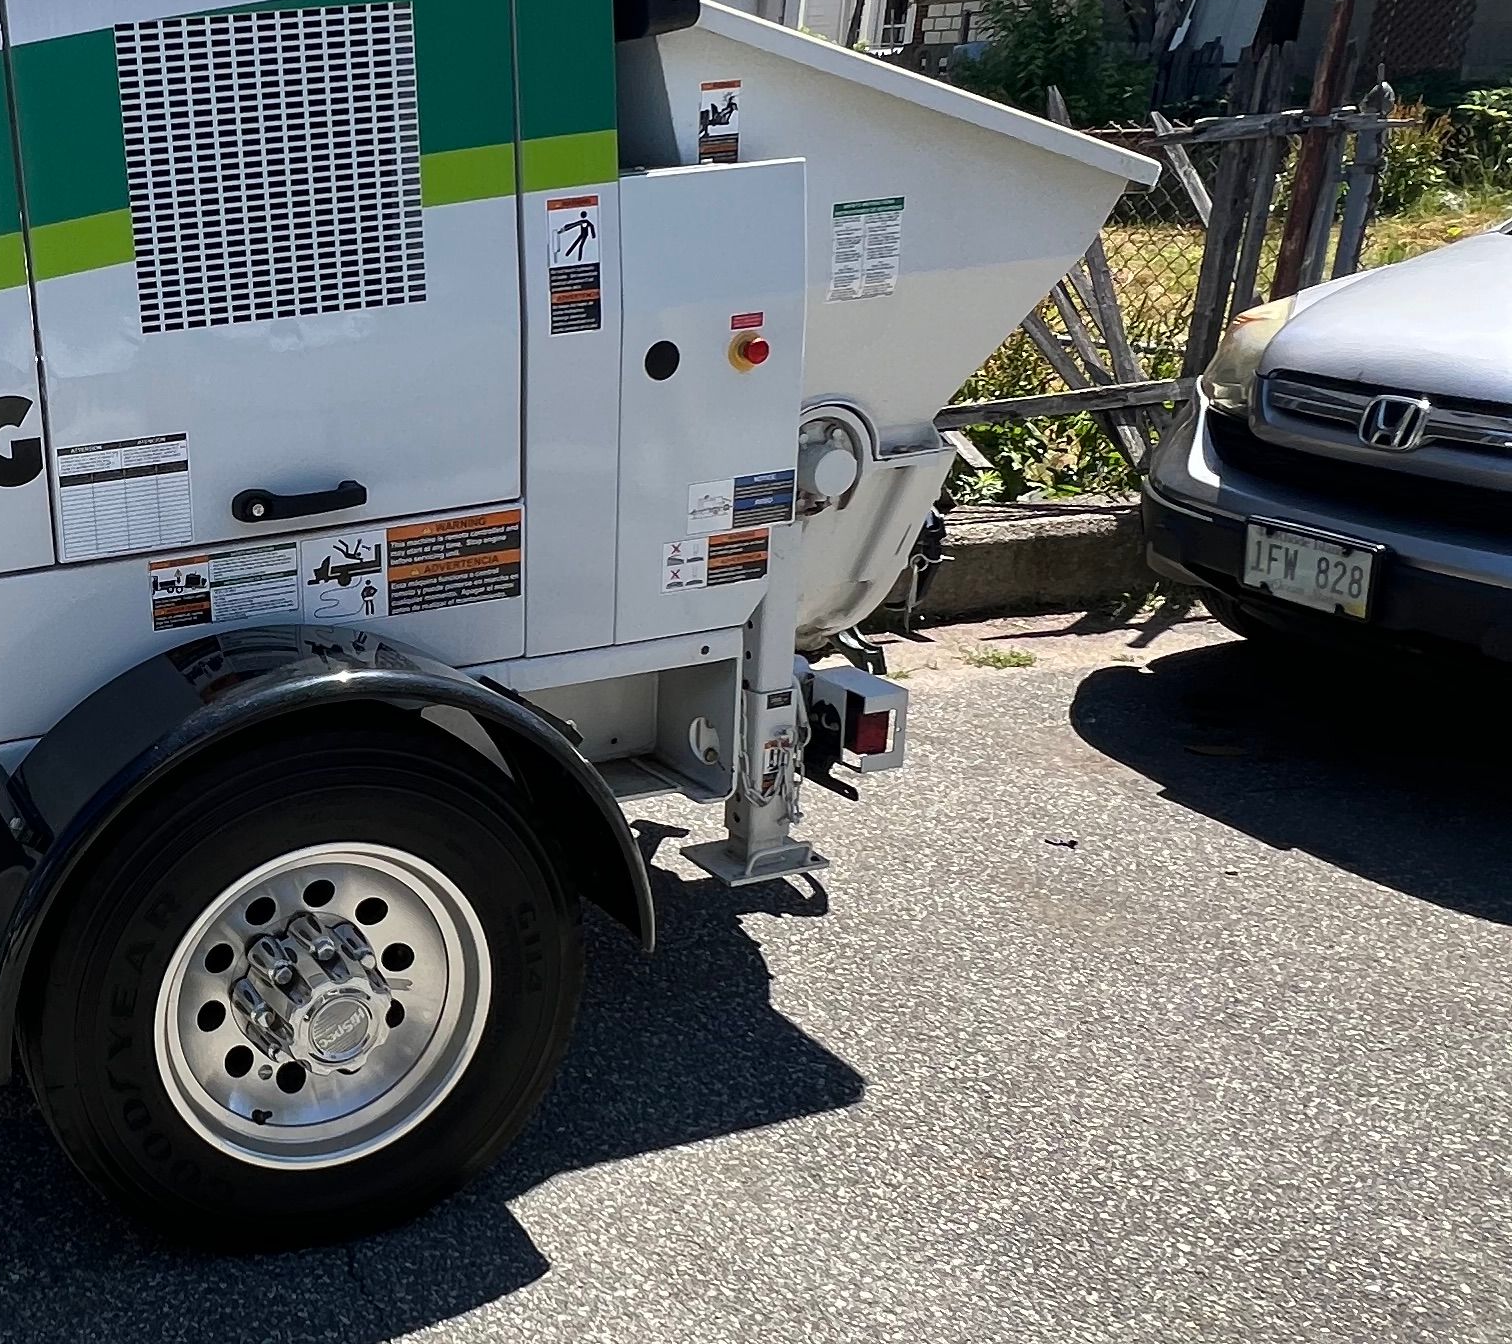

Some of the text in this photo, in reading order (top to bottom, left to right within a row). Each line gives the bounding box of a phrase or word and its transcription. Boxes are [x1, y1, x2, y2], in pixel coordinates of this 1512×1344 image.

[436, 517, 486, 532] WARNING
[424, 555, 499, 573] ADVERTENCIA
[1251, 540, 1299, 581] 1FW
[1315, 556, 1364, 599] 828
